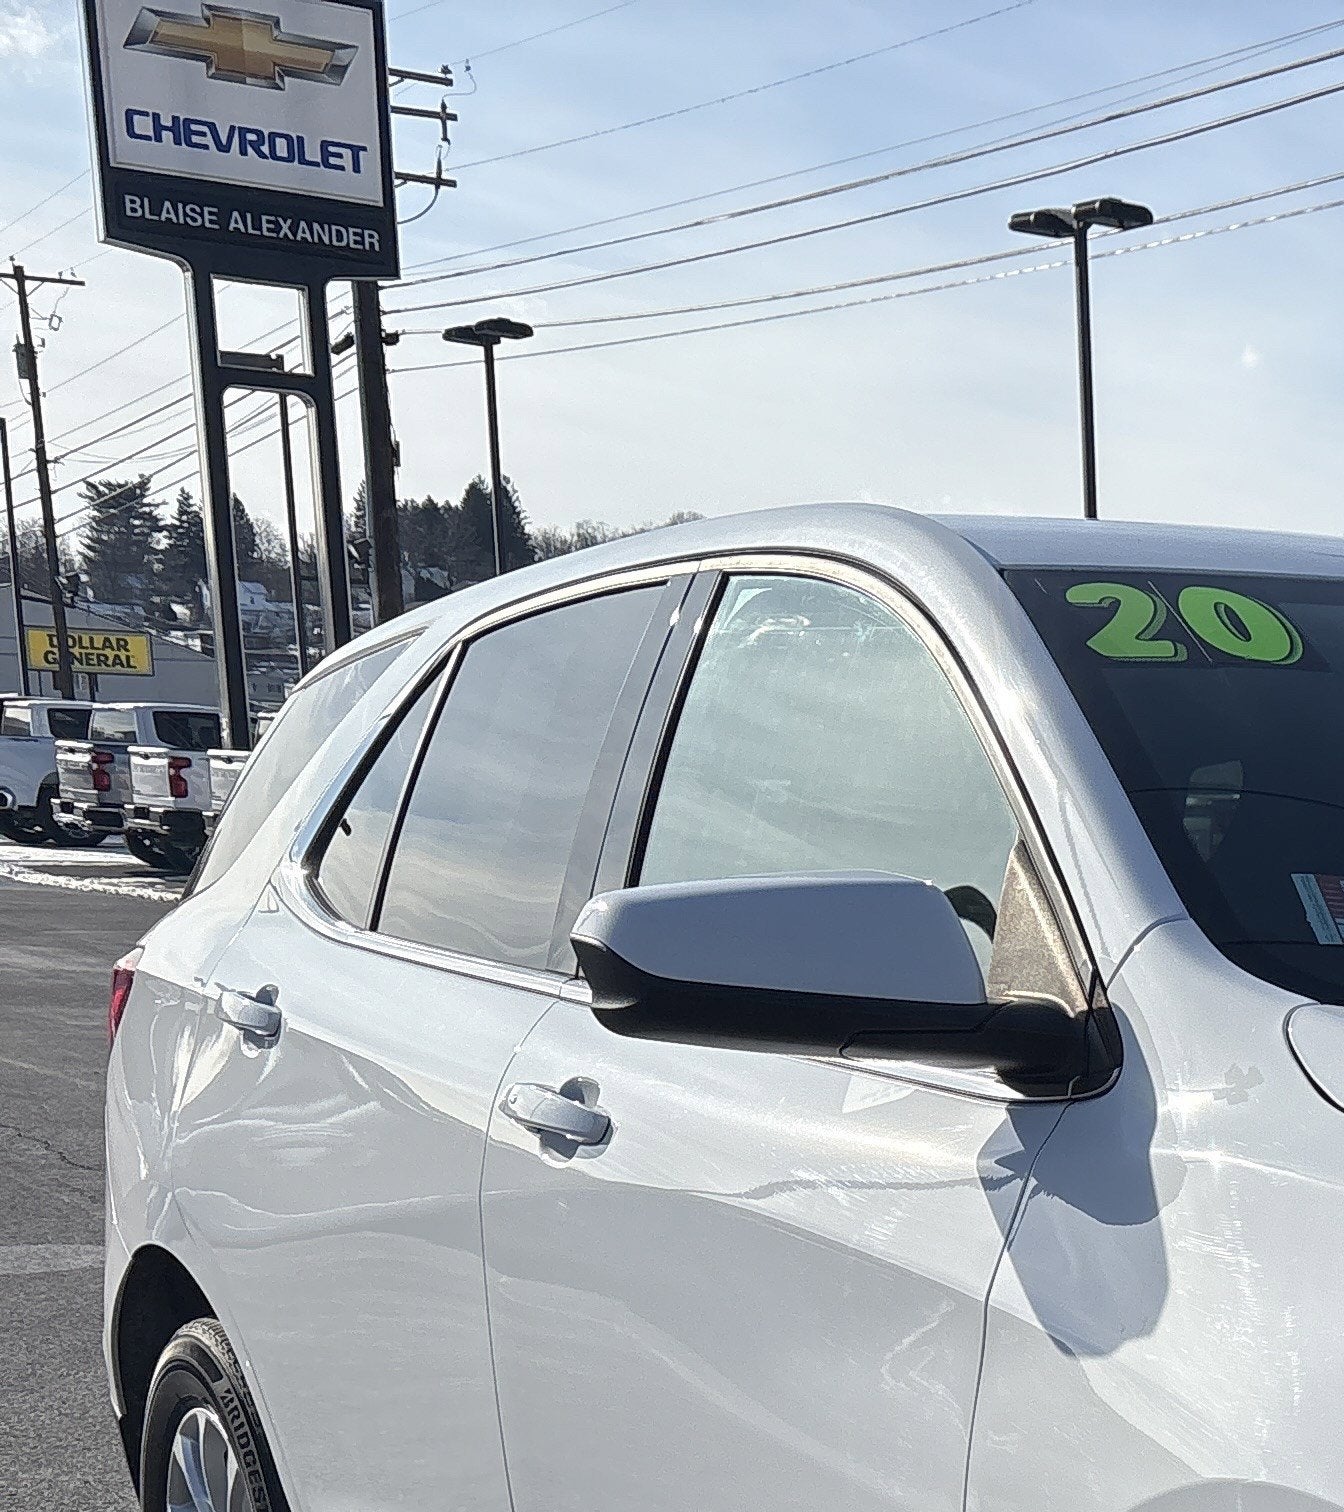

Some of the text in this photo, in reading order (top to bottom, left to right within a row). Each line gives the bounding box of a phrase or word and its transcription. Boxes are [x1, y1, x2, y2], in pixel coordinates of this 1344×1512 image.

[124, 108, 368, 175] CHEVROLET
[124, 194, 381, 252] BLAISE ALEXANDER
[1065, 582, 1303, 665] 20
[43, 650, 137, 669] GNERAL
